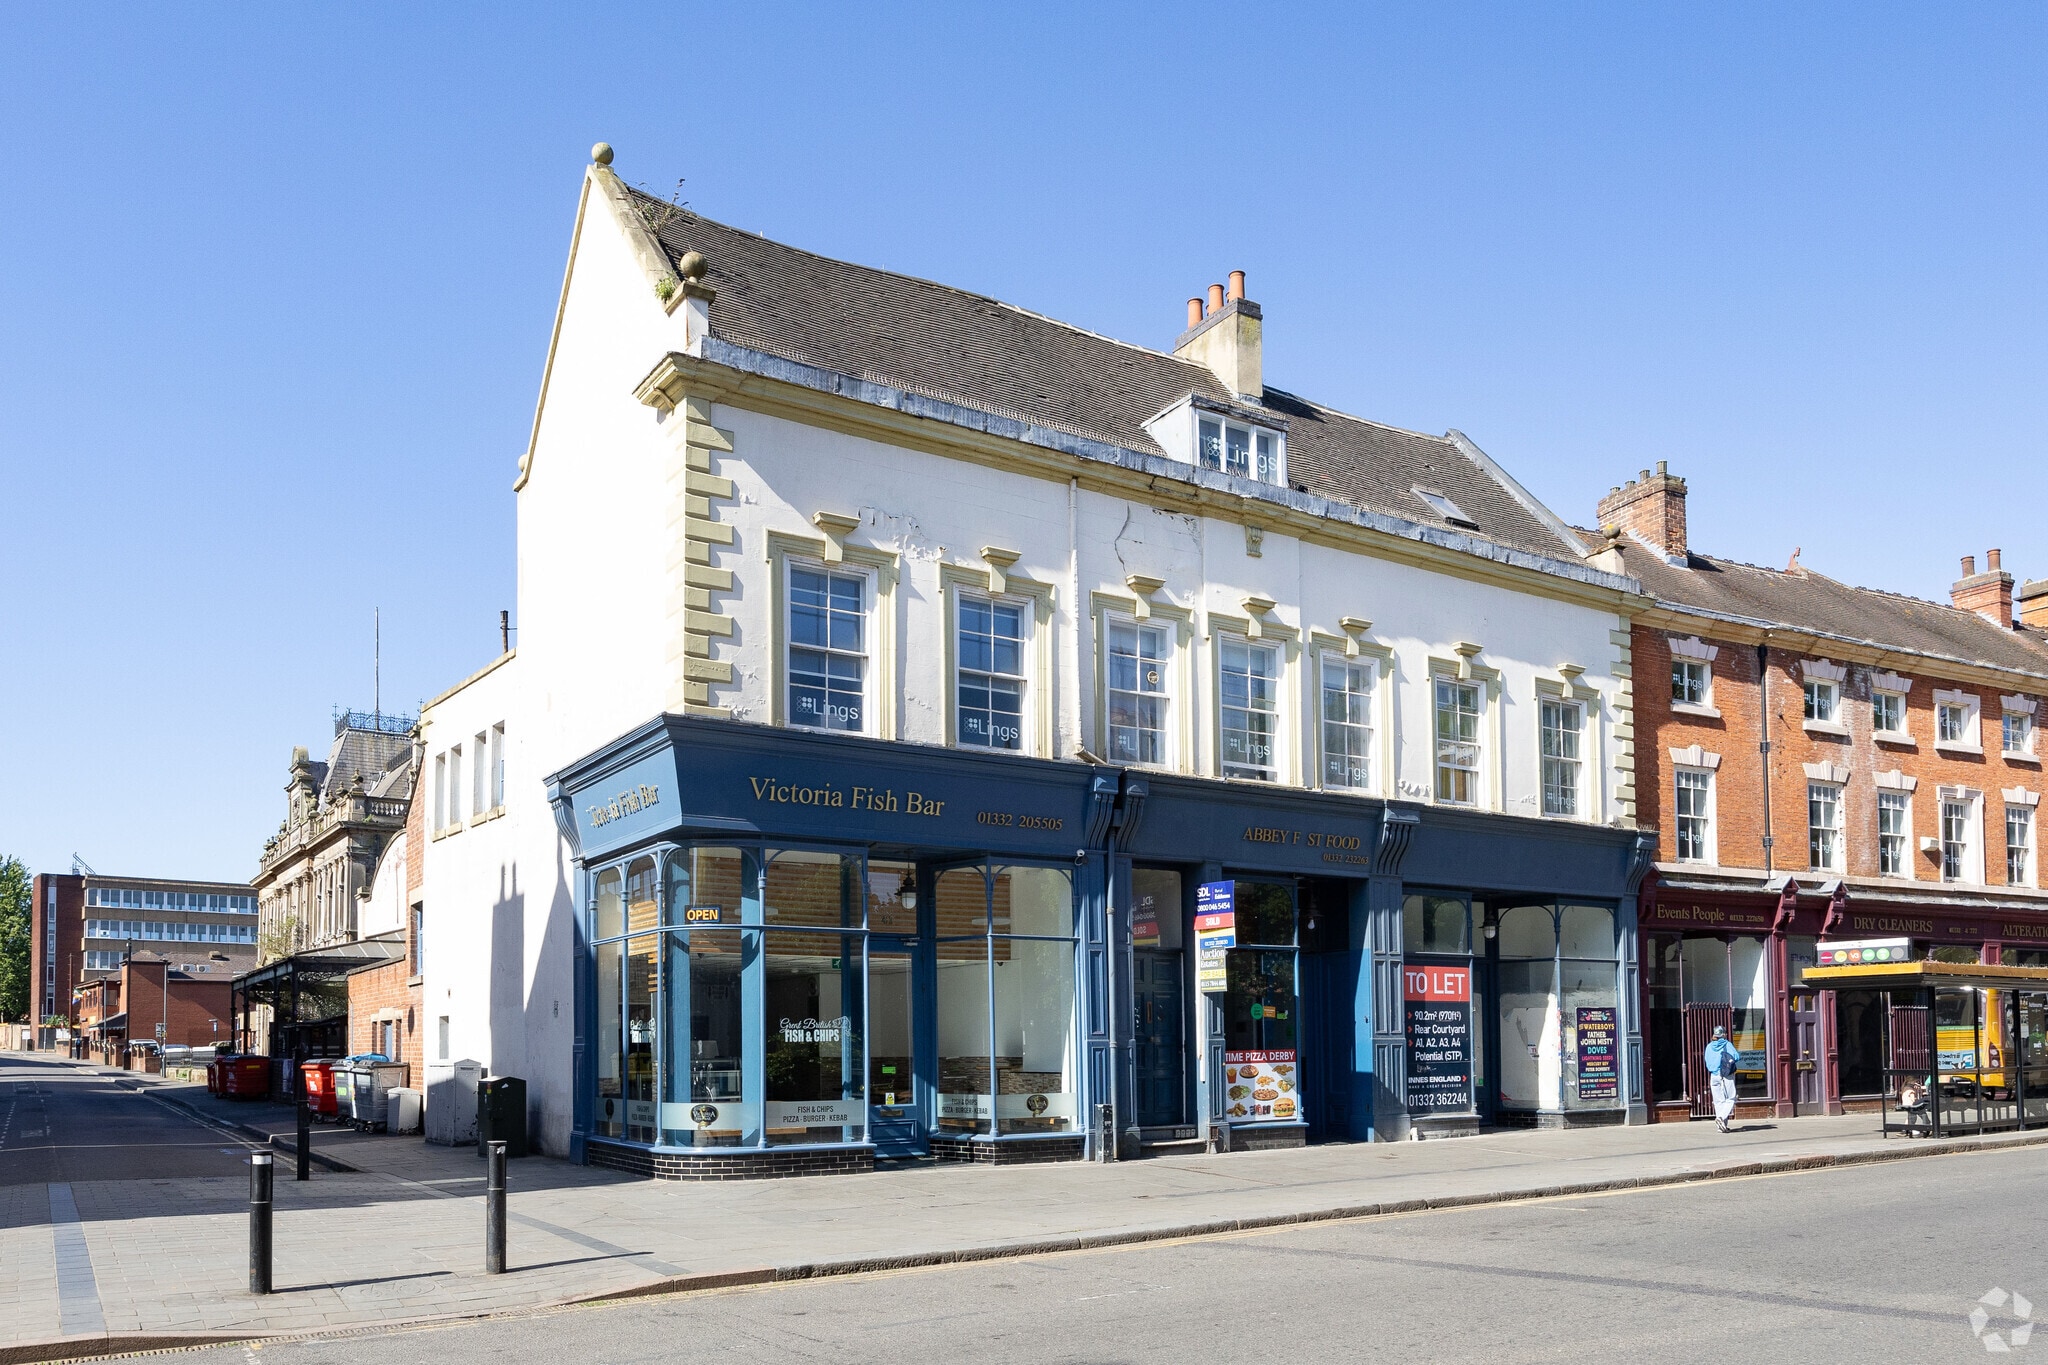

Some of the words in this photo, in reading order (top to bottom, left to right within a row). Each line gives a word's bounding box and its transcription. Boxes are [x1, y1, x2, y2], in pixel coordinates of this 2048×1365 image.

[813, 698, 859, 722] Lings
[979, 719, 1019, 742] Lings
[1338, 761, 1368, 781] Lngs
[748, 776, 843, 807] Victoria
[850, 786, 898, 812] Fish
[905, 791, 945, 817] Bar
[977, 811, 1013, 826] 01332
[1018, 815, 1063, 831] 205505
[1243, 827, 1289, 844] ABBEY
[1326, 835, 1360, 850] FOOD
[1197, 887, 1210, 898] SDL
[687, 909, 718, 920] OPEN
[1657, 904, 1690, 919] Events
[1692, 905, 1725, 923] People
[1205, 917, 1220, 926] SOLD
[1853, 917, 1876, 931] DRY
[1878, 918, 1933, 932] CLEANERS
[2002, 924, 2048, 938] ALTERATI
[1201, 949, 1225, 958] Auction
[1406, 972, 1428, 994] TO
[1433, 973, 1465, 995] LET
[780, 1018, 802, 1033] Great
[1415, 1025, 1431, 1034] Rear
[1432, 1024, 1466, 1036] Courtyard
[785, 1030, 804, 1043] FISH
[806, 1031, 812, 1042] &
[814, 1029, 840, 1042] CHIPS
[1587, 1031, 1607, 1039] FATHER
[1451, 1037, 1461, 1047] A4
[1225, 1053, 1243, 1062] TIME
[1245, 1052, 1267, 1061] PIZZA
[1270, 1051, 1295, 1061] DERBY
[1415, 1051, 1443, 1061] Potential
[1445, 1051, 1462, 1061] (STP)
[1587, 1046, 1607, 1054] DOVES
[1408, 1076, 1428, 1084] INNES
[1429, 1075, 1461, 1083] ENGLAND
[1409, 1093, 1435, 1107] 01332
[1436, 1092, 1467, 1106] 362244
[816, 1105, 834, 1113] CHIPS
[782, 1115, 800, 1123] PIZZA
[803, 1114, 826, 1122] BURGER
